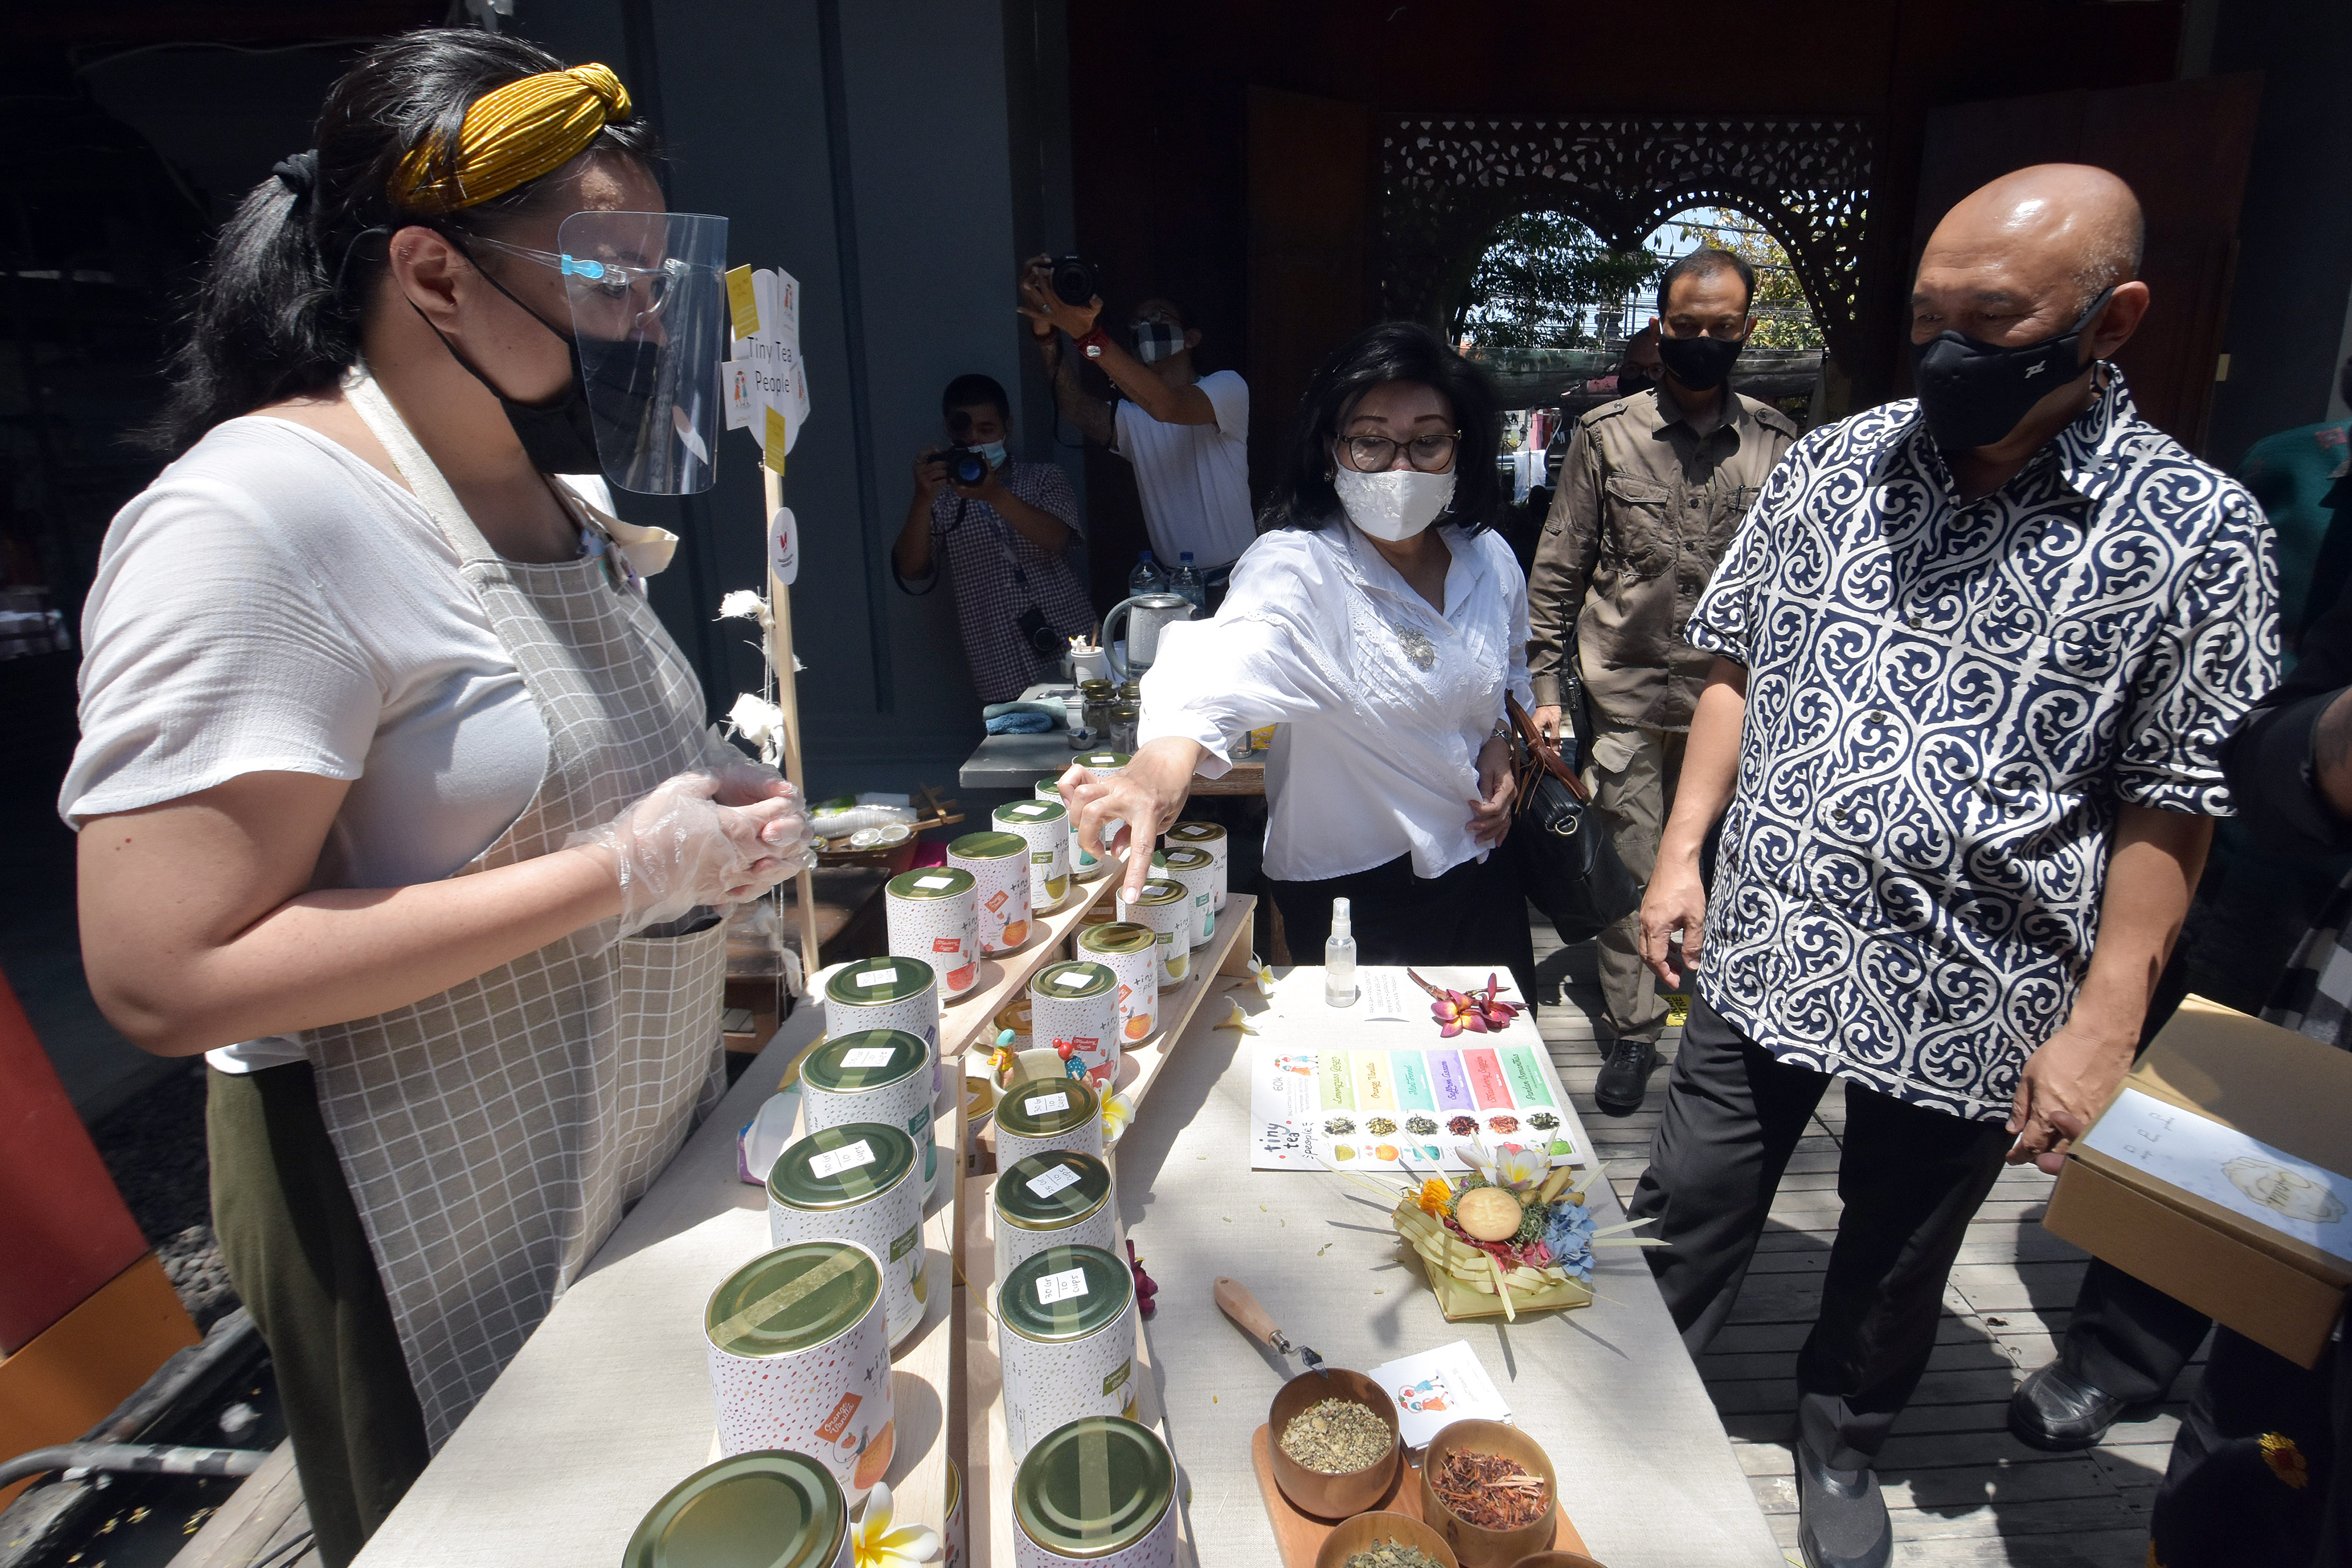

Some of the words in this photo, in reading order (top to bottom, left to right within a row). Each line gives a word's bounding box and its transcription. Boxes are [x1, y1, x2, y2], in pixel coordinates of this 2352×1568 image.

[747, 336, 772, 363] Tiny
[776, 341, 792, 362] Tea
[755, 370, 790, 396] People
[1330, 1056, 1342, 1072] Ginger
[1365, 1062, 1377, 1080] Vanilla
[1441, 1060, 1451, 1078] Assam
[1512, 1054, 1528, 1080] Osmanthus
[1272, 1076, 1283, 1091] 60k
[1332, 1074, 1344, 1104] Lemongrass
[1371, 1081, 1382, 1099] Orange
[1407, 1078, 1418, 1095] Mint
[1445, 1078, 1459, 1100] Saffron
[1483, 1072, 1496, 1103] Strawberry
[1522, 1080, 1536, 1101] Pandan
[1259, 1123, 1291, 1152] tiny
[1283, 1132, 1300, 1149] tea
[1304, 1127, 1319, 1156] people
[843, 1154, 851, 1163] 10
[855, 1146, 865, 1161] cups
[1058, 1168, 1074, 1181] cups
[1061, 1281, 1068, 1290] 10
[1071, 1275, 1081, 1293] cups
[824, 1402, 847, 1432] Orange
[829, 1403, 854, 1434] Vanilla
